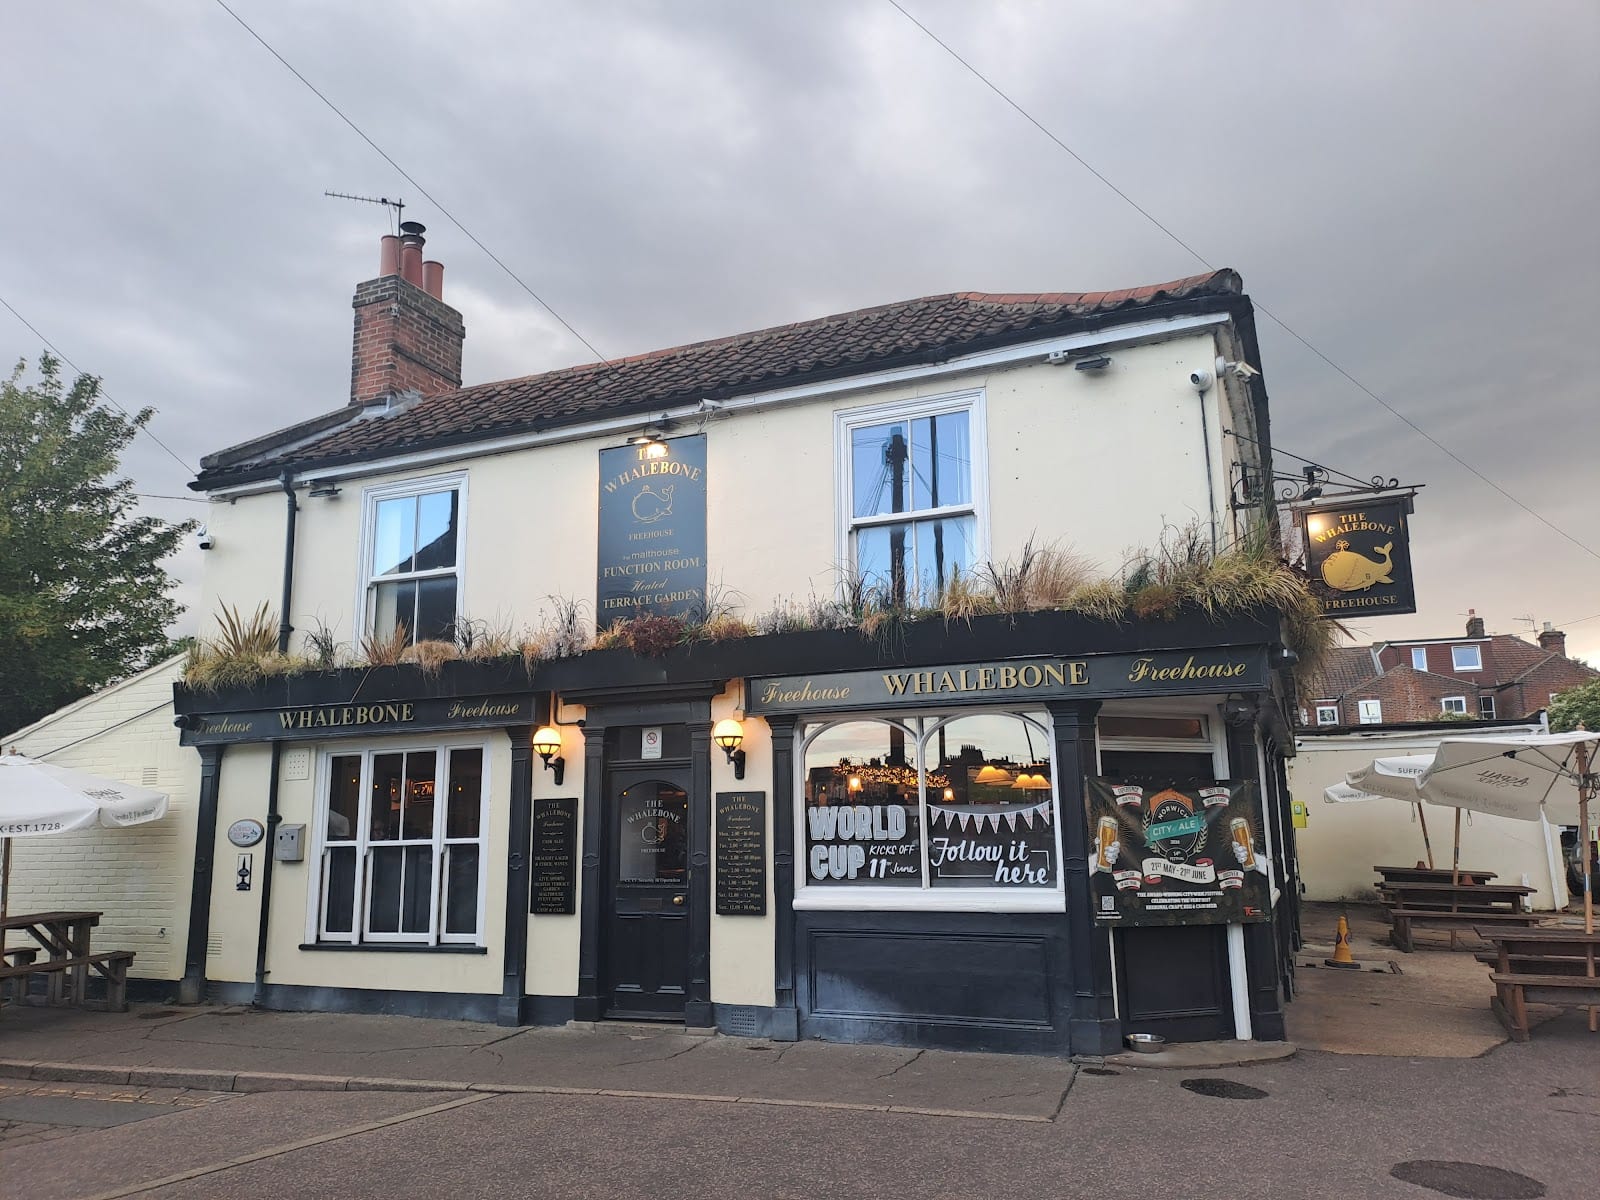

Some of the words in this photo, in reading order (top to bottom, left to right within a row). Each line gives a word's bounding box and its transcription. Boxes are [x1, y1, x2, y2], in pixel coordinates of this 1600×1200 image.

[604, 461, 702, 493] WHALEBONE
[1339, 513, 1366, 523] THE
[629, 529, 674, 541] FREEHOUSE
[1315, 522, 1395, 543] WHALEBONE
[632, 548, 680, 560] malthouse
[604, 563, 660, 578] FUNCTION
[664, 558, 700, 570] ROOM
[630, 578, 668, 592] Heated
[603, 594, 652, 608] TERRACE
[655, 590, 700, 604] GARDEN
[1326, 595, 1398, 610] FREEHOUSE
[761, 682, 850, 704] Freehouse
[882, 661, 1090, 695] WHALEBONE
[1127, 655, 1246, 683] Freehouse
[279, 703, 414, 729] WHALEBONE
[447, 699, 519, 718] Freehouse
[645, 800, 663, 808] THE
[720, 804, 760, 814] WHALEBONE
[1158, 804, 1189, 820] NORWICH
[627, 809, 680, 824] WHALEBONE
[809, 805, 906, 841] WORLD
[1153, 825, 1172, 836] CITY
[1178, 820, 1196, 830] ALE
[869, 845, 897, 855] KICKS
[899, 844, 916, 855] OFF
[930, 838, 1002, 866] Follow
[1009, 841, 1029, 862] it
[810, 844, 866, 880] CUP
[890, 862, 918, 874] June
[994, 859, 1049, 885] here
[1164, 864, 1176, 874] MAY
[1192, 870, 1207, 880] JUNE
